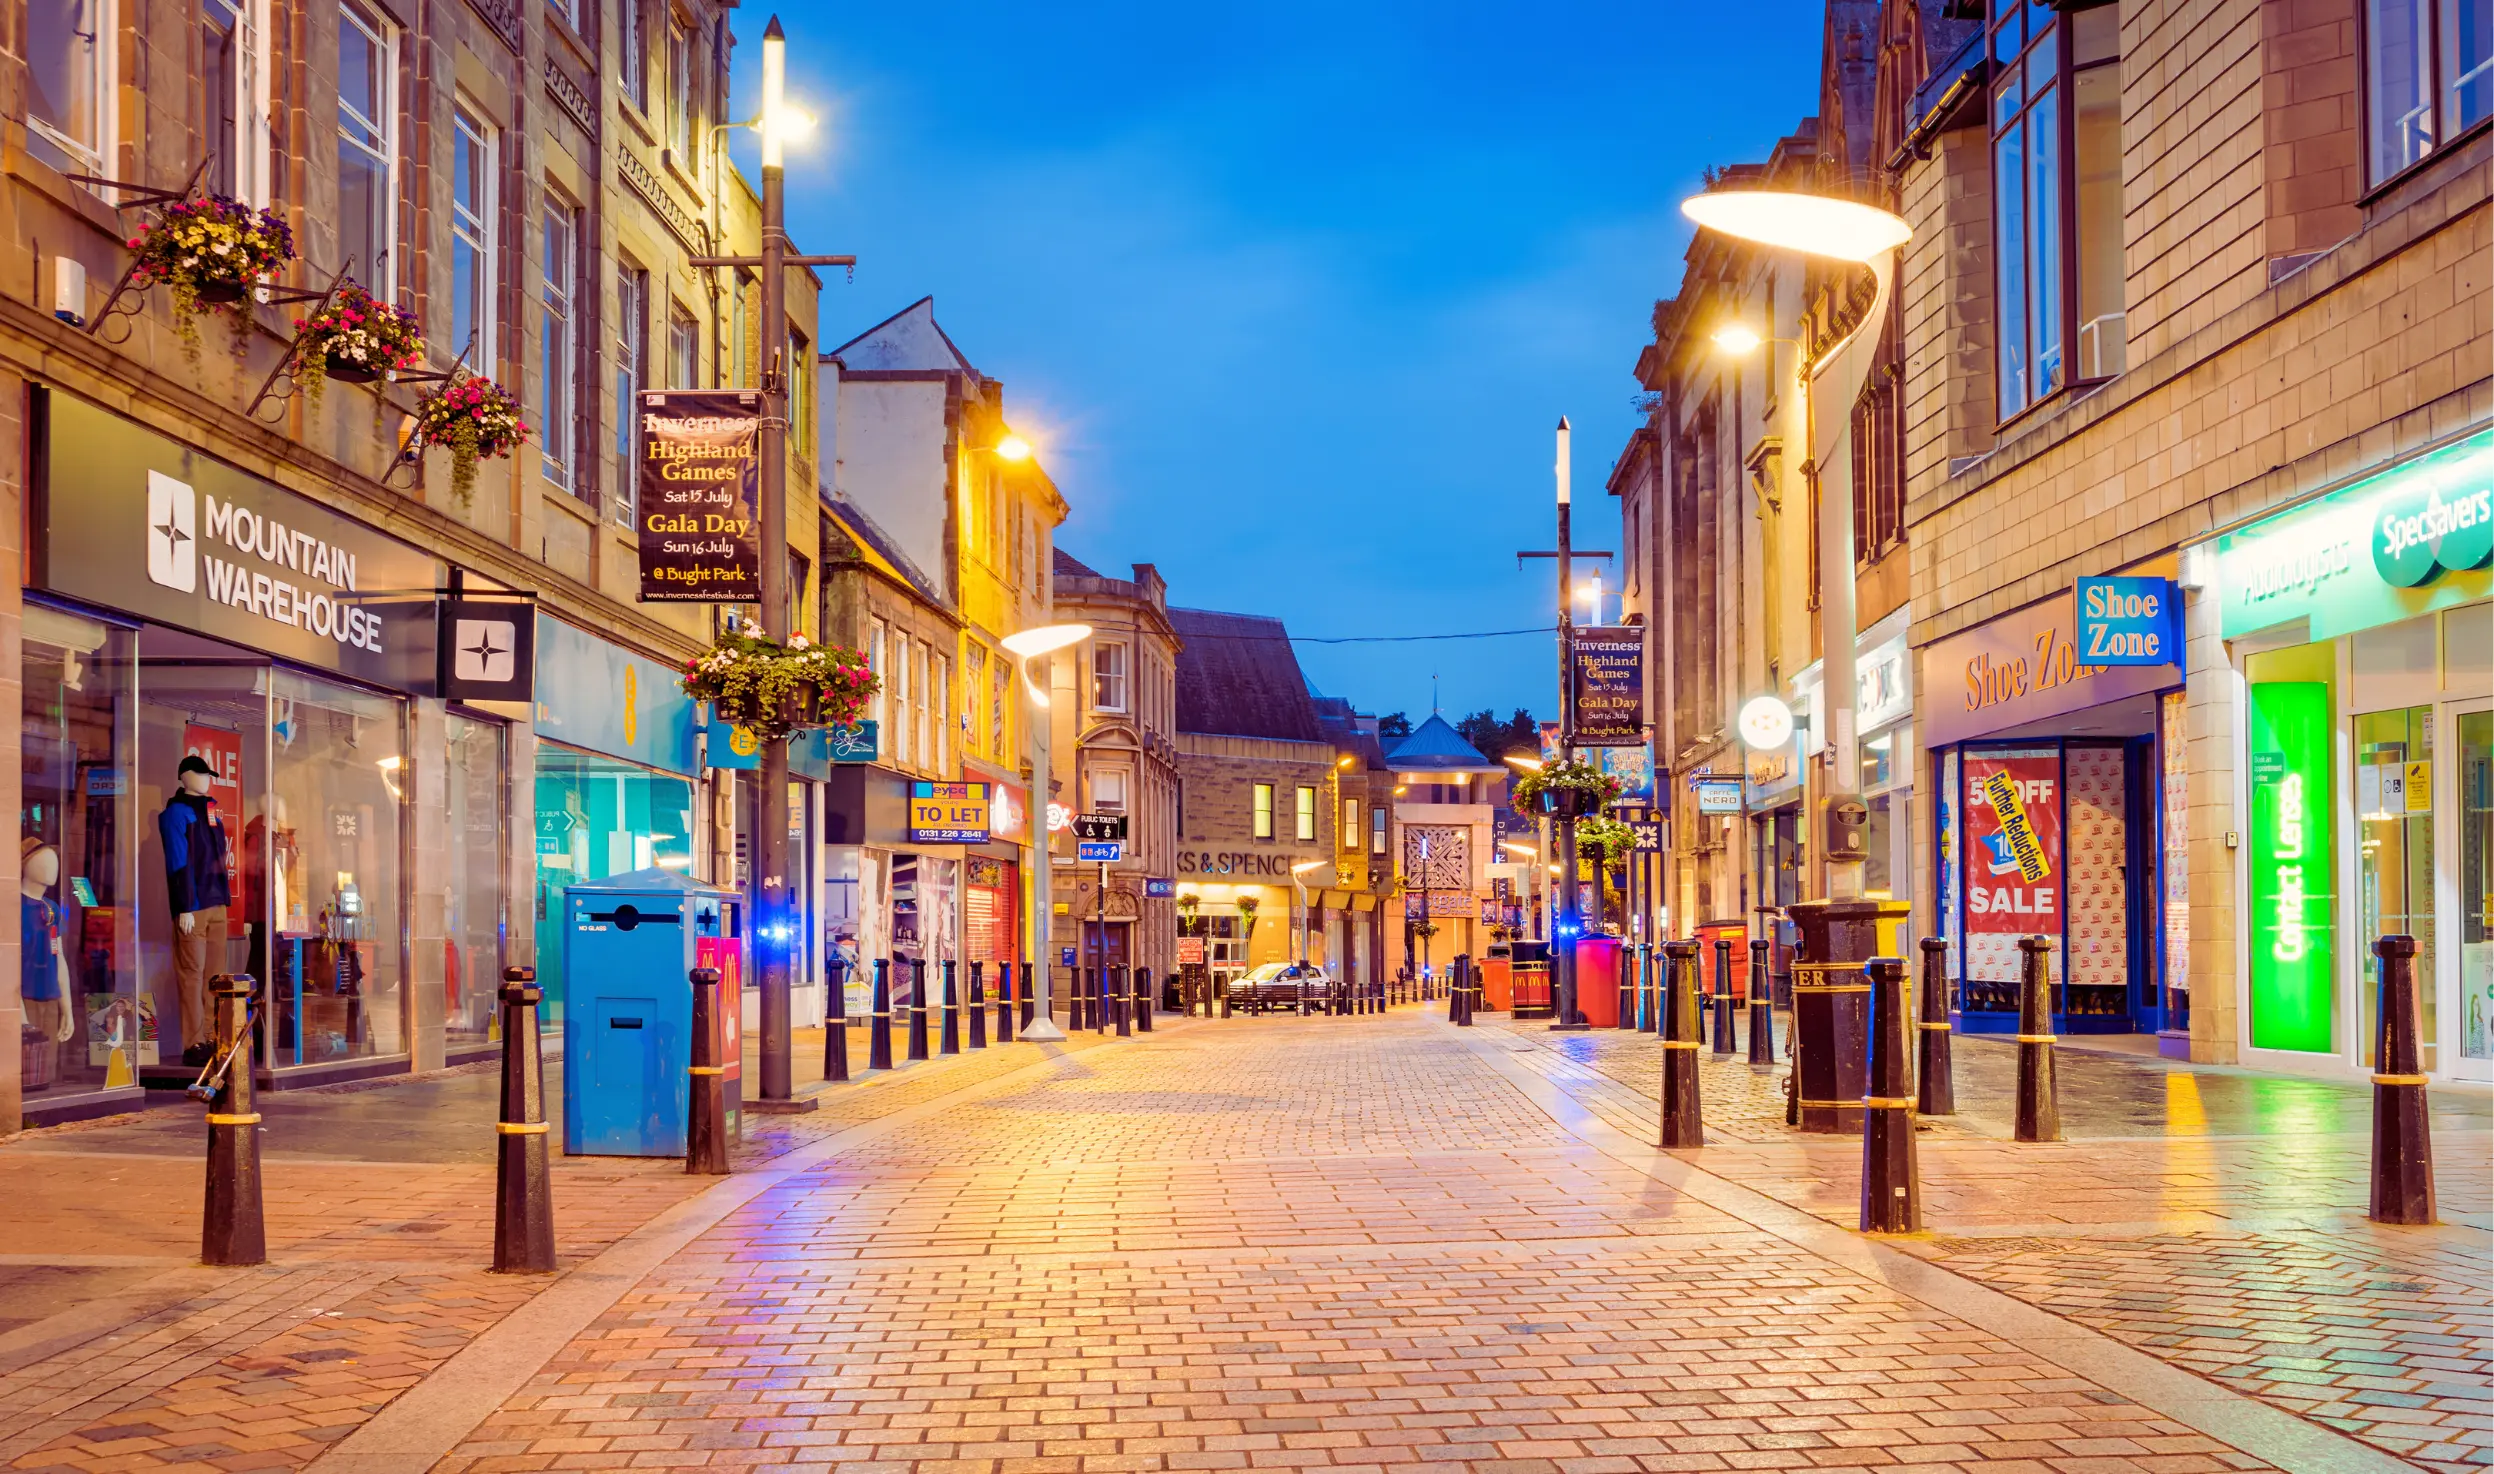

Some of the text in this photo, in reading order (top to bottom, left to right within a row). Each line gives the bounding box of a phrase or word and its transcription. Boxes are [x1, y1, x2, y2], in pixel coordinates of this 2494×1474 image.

[645, 413, 757, 433] Inverness
[648, 440, 751, 464] Highland
[661, 462, 737, 481] Games
[664, 487, 733, 508] Sat 15 July
[647, 514, 750, 539] Gala Day
[2383, 490, 2491, 560] Specsavers
[204, 494, 357, 591] MOUNTAIN
[663, 537, 734, 559] Sun 16 July
[653, 563, 746, 586] @ Bught Park
[203, 554, 383, 653] WAREHOUSE
[645, 589, 755, 602] www.invernessfestivals.com
[2086, 585, 2158, 619] Shoe
[1575, 639, 1640, 652] Inverness
[2087, 623, 2160, 657] Zone
[1577, 655, 1638, 669] Highland
[1586, 668, 1630, 679] Games
[1965, 653, 2028, 712] Shoe
[1611, 682, 1628, 694] July
[1578, 697, 1638, 711] Gala Day
[1612, 710, 1629, 722] July
[1589, 724, 1614, 737] Bught
[1616, 724, 1635, 734] Park
[1704, 796, 1737, 804] NERO
[917, 807, 982, 823] TO LET
[1081, 815, 1118, 824] PUBLIC TOILETS
[2274, 773, 2303, 860] Lenses
[941, 830, 958, 838] 226
[1987, 772, 2017, 818] Further
[2004, 814, 2043, 881] Reductions
[1201, 852, 1213, 873] &
[1151, 883, 1173, 892] TSB
[1969, 888, 2054, 914] SALE
[2274, 865, 2303, 962] Contact
